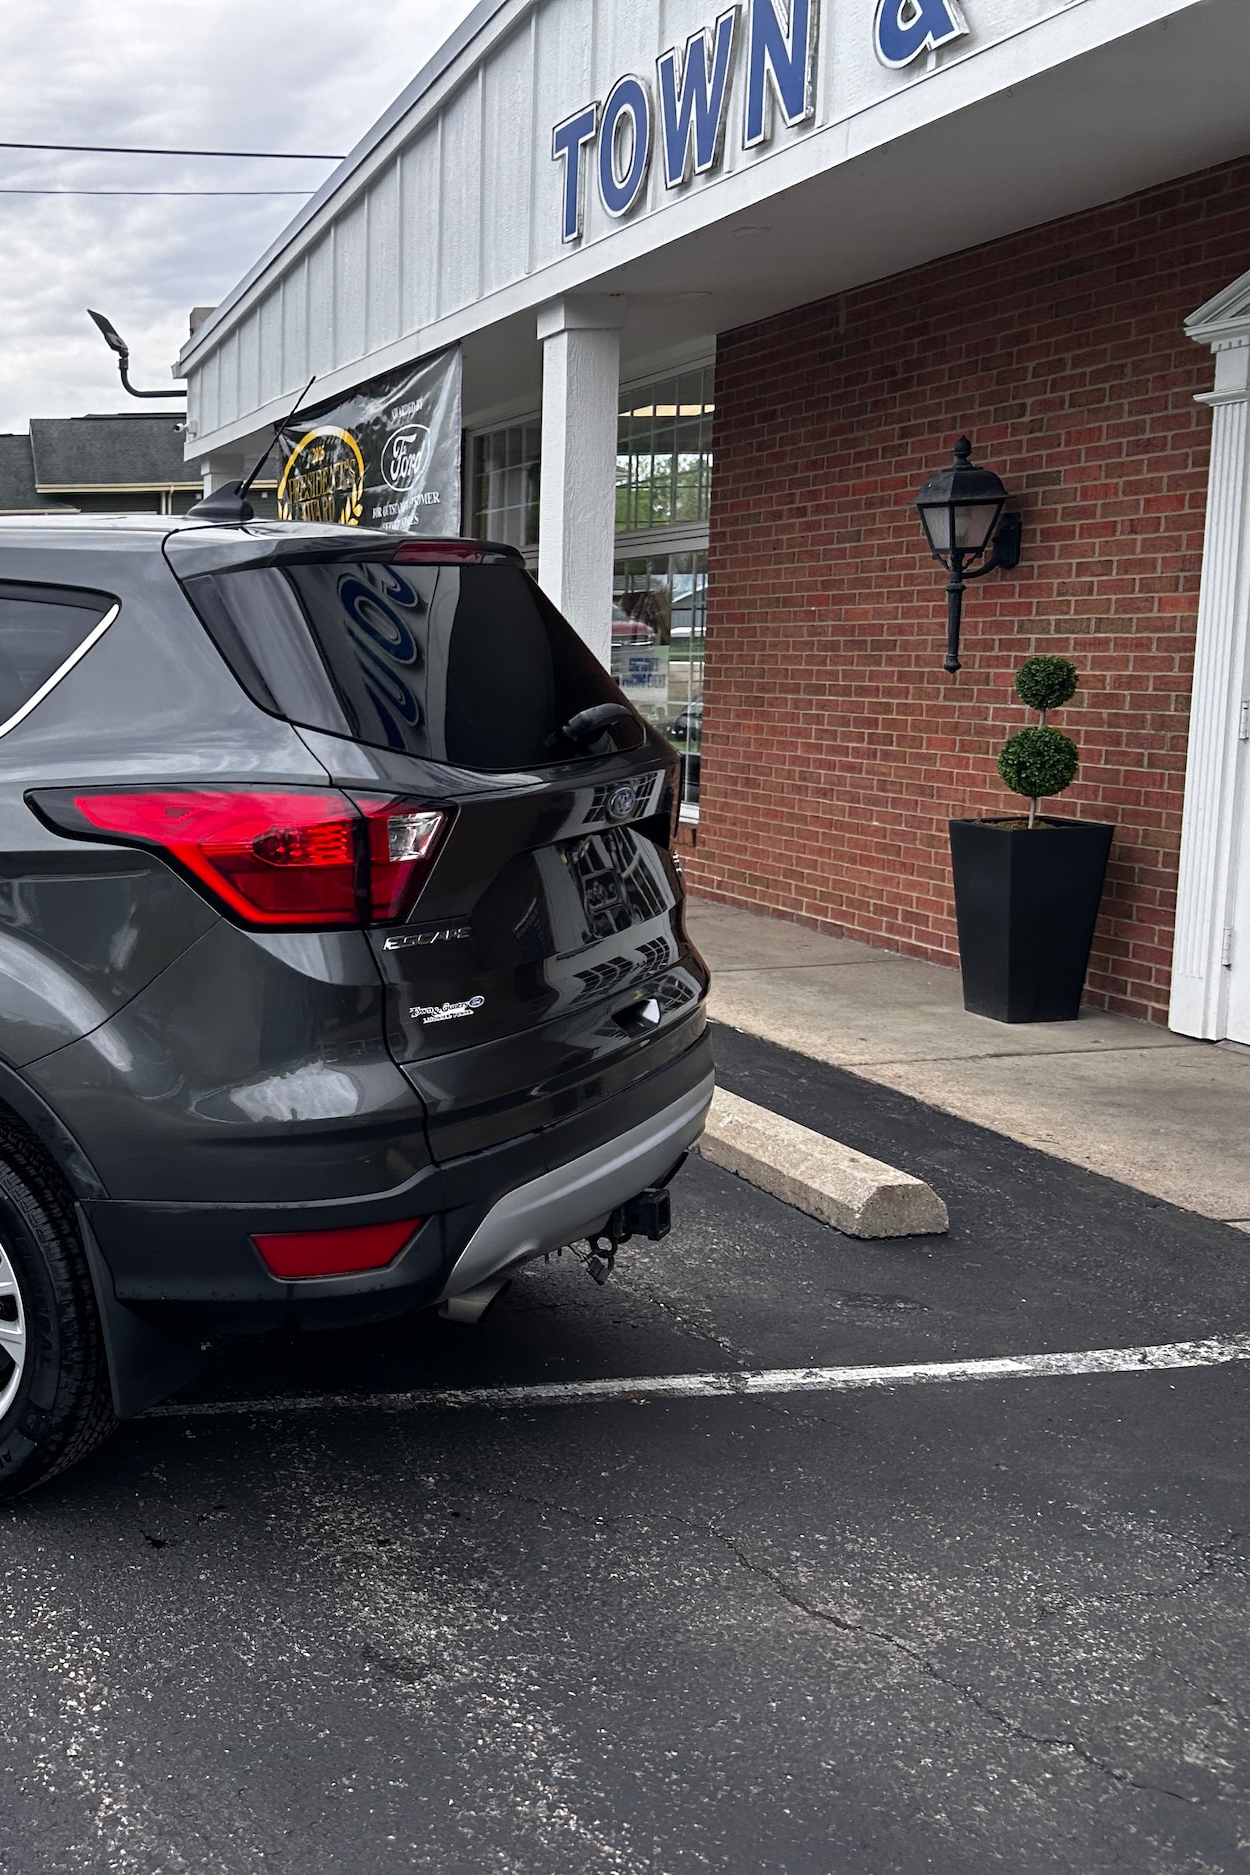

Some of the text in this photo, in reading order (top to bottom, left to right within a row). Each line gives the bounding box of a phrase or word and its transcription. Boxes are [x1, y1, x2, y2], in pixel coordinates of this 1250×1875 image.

[551, 0, 810, 244] TOWN
[390, 433, 426, 481] Ford
[383, 926, 472, 951] ESCAPE
